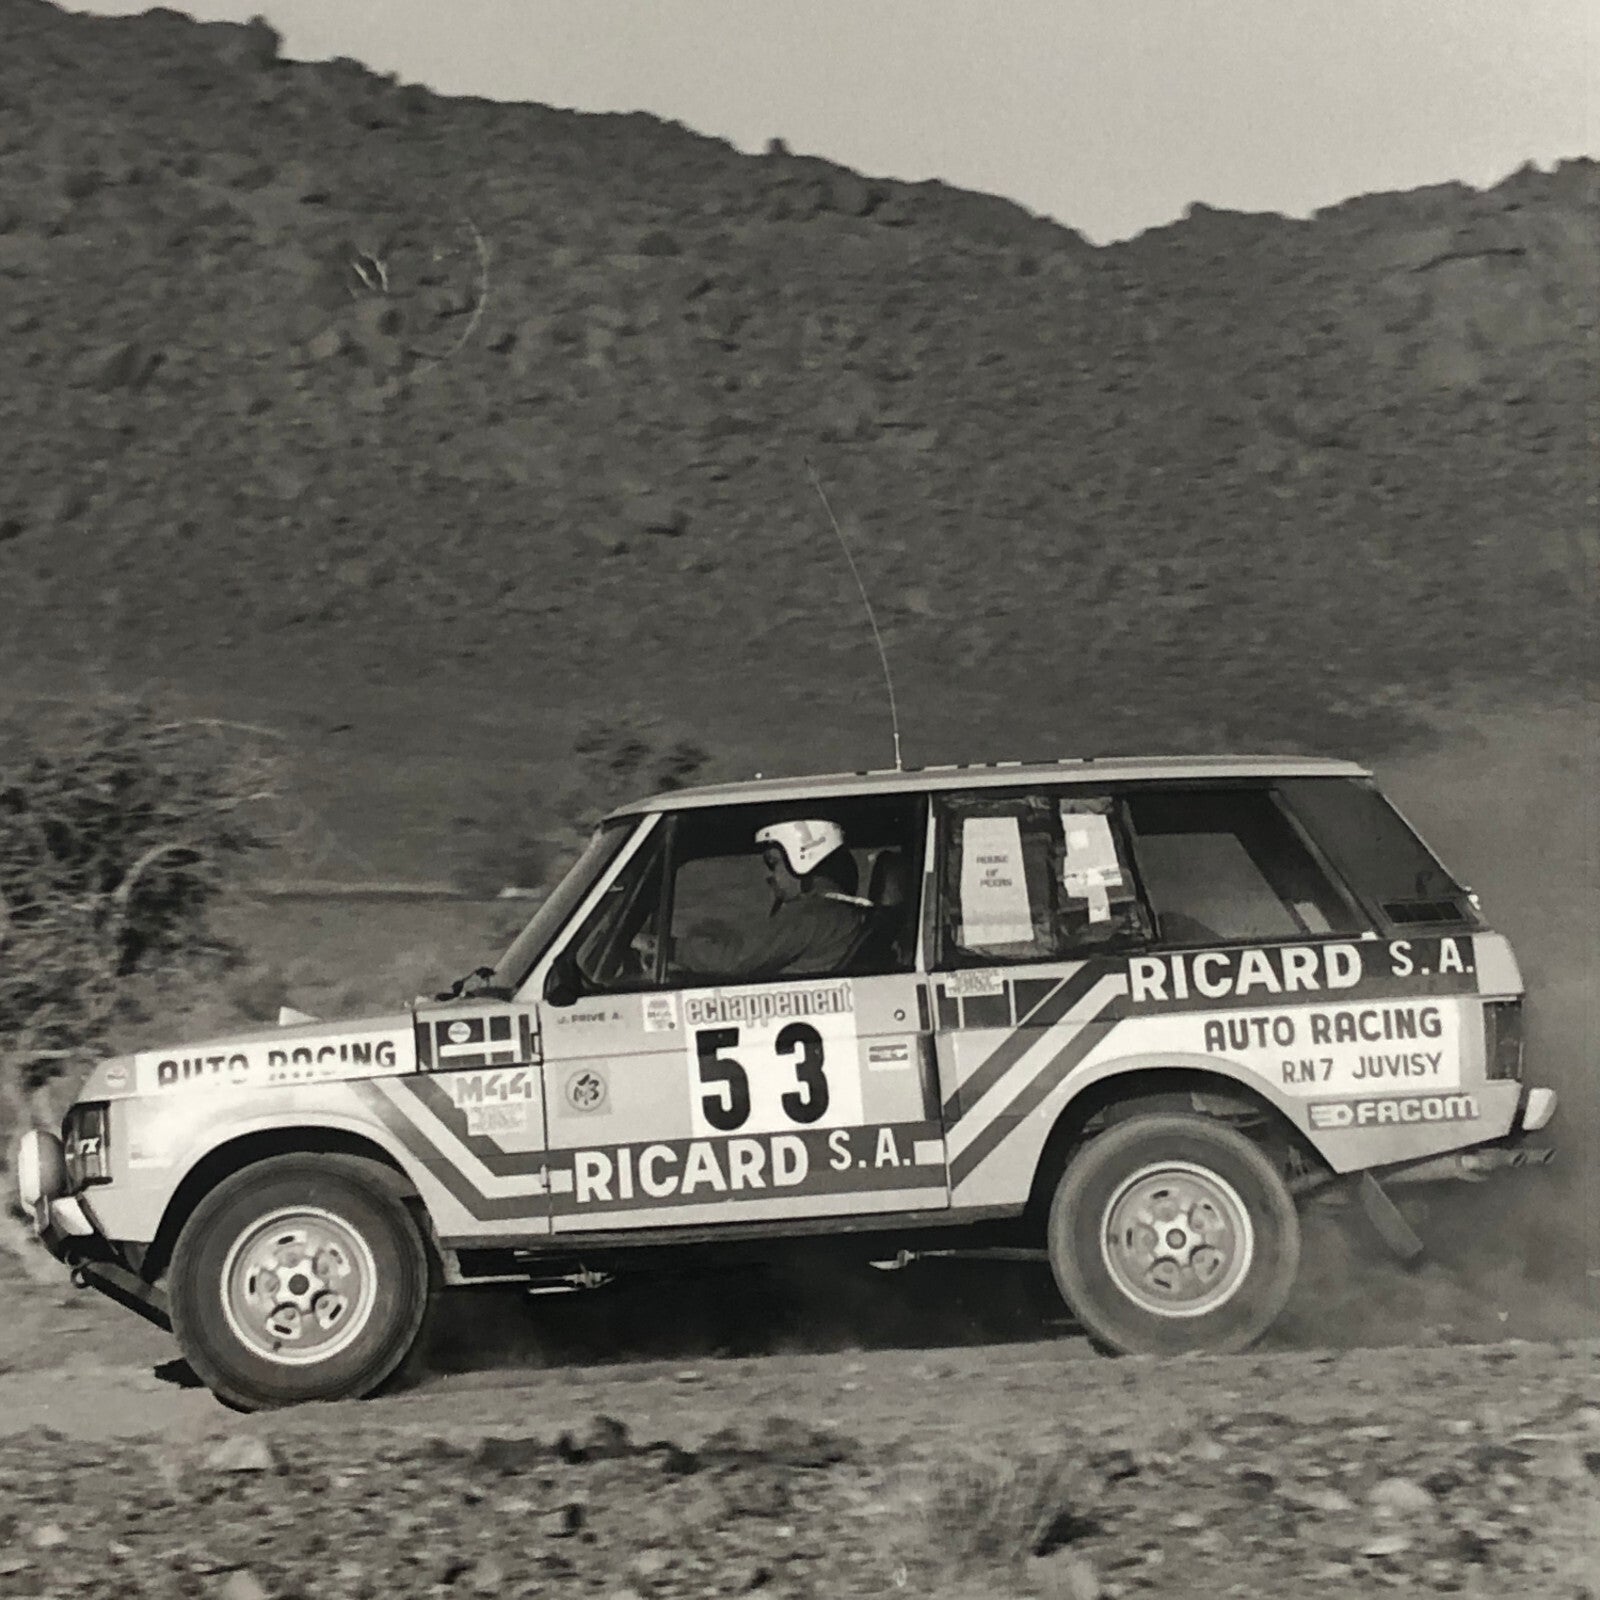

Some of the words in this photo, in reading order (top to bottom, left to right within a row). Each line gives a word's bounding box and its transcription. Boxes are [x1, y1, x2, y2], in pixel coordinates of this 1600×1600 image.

[1128, 943, 1362, 1002] RICARD
[1389, 937, 1474, 976] S.A.
[686, 982, 853, 1028] echappement
[1204, 1015, 1295, 1052] AUTO
[1310, 997, 1442, 1045] RACING
[695, 1021, 830, 1131] 53
[1352, 1052, 1443, 1080] JUVISY
[1356, 1095, 1480, 1125] FACOM
[574, 1135, 809, 1204] RICARD
[828, 1127, 911, 1171] S.A.
